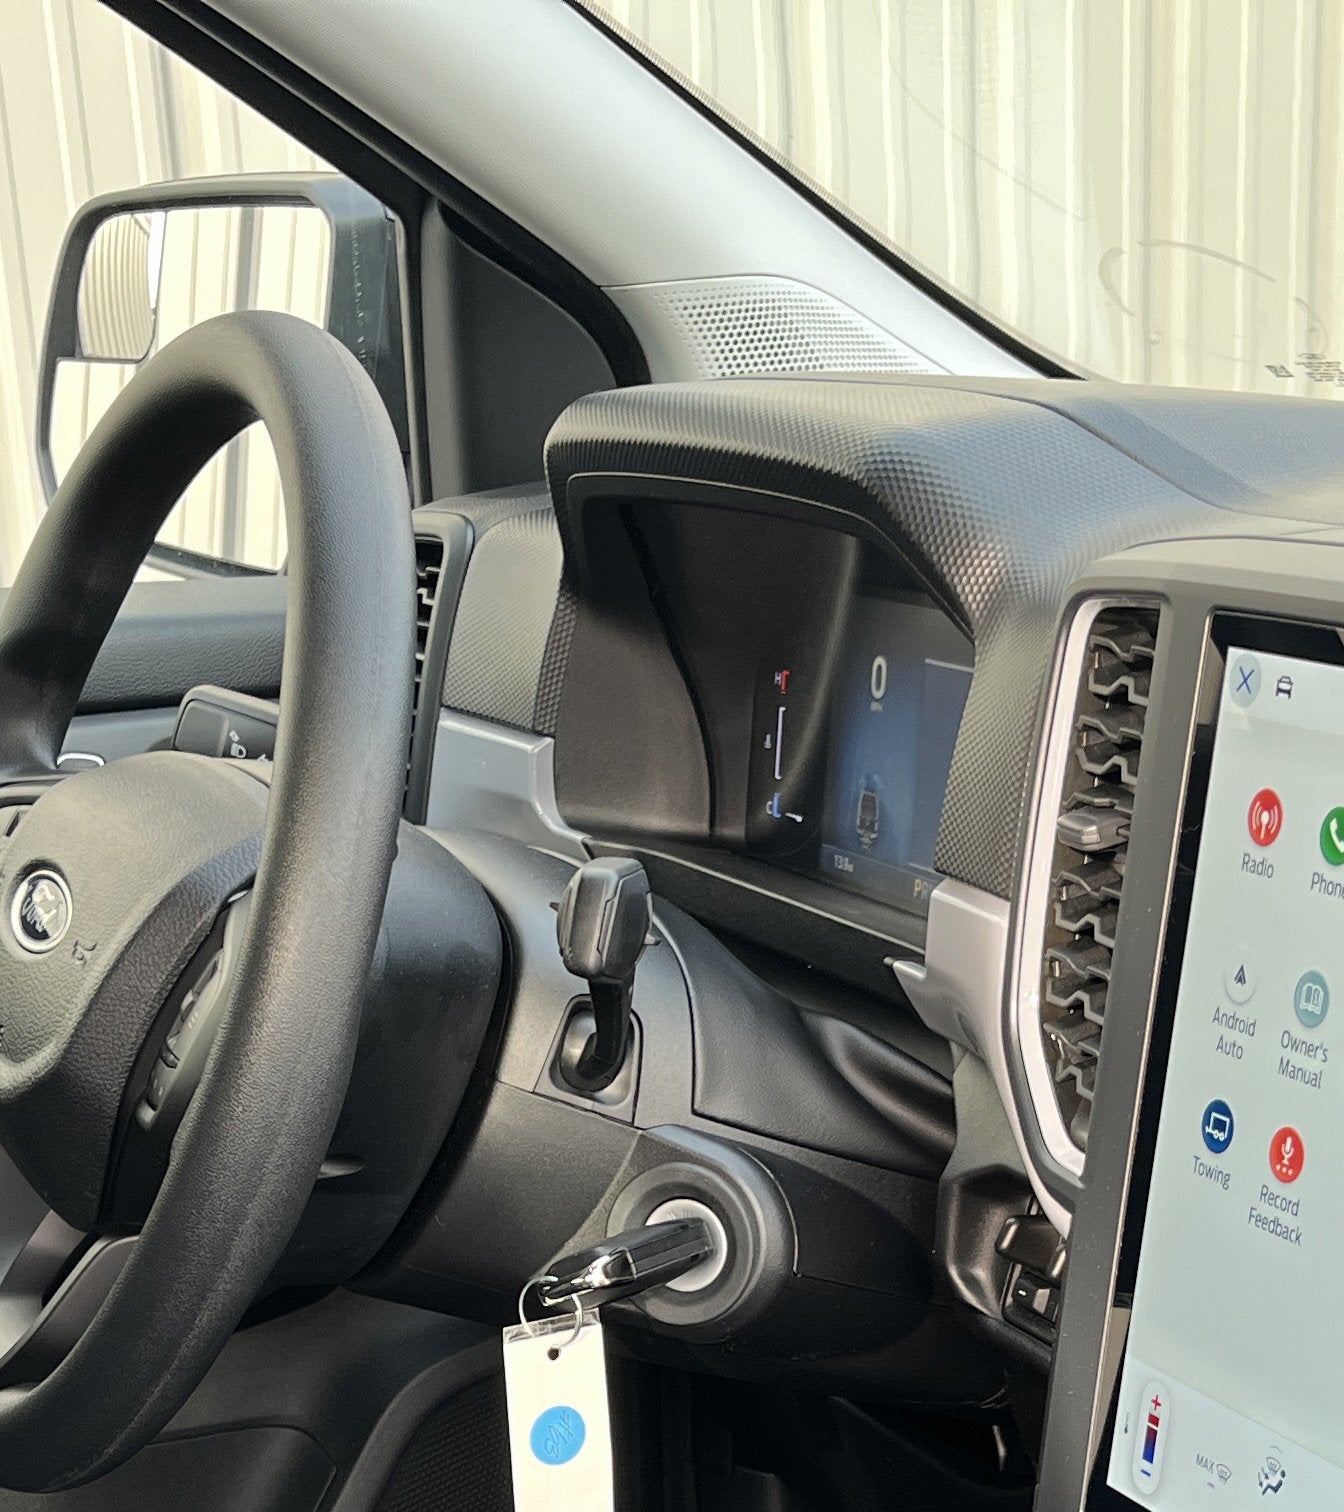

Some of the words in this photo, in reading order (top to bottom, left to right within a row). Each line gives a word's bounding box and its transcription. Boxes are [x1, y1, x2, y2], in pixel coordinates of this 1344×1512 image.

[1241, 852, 1274, 879] Radio
[1212, 1006, 1256, 1037] Android
[1215, 1036, 1244, 1060] Auto
[1280, 1030, 1329, 1063] Owner's
[1278, 1056, 1322, 1089] Manual
[1192, 1155, 1231, 1190] Towing
[1260, 1184, 1300, 1217] Record
[1248, 1207, 1303, 1246] Feedback
[1196, 1453, 1215, 1474] MAX
